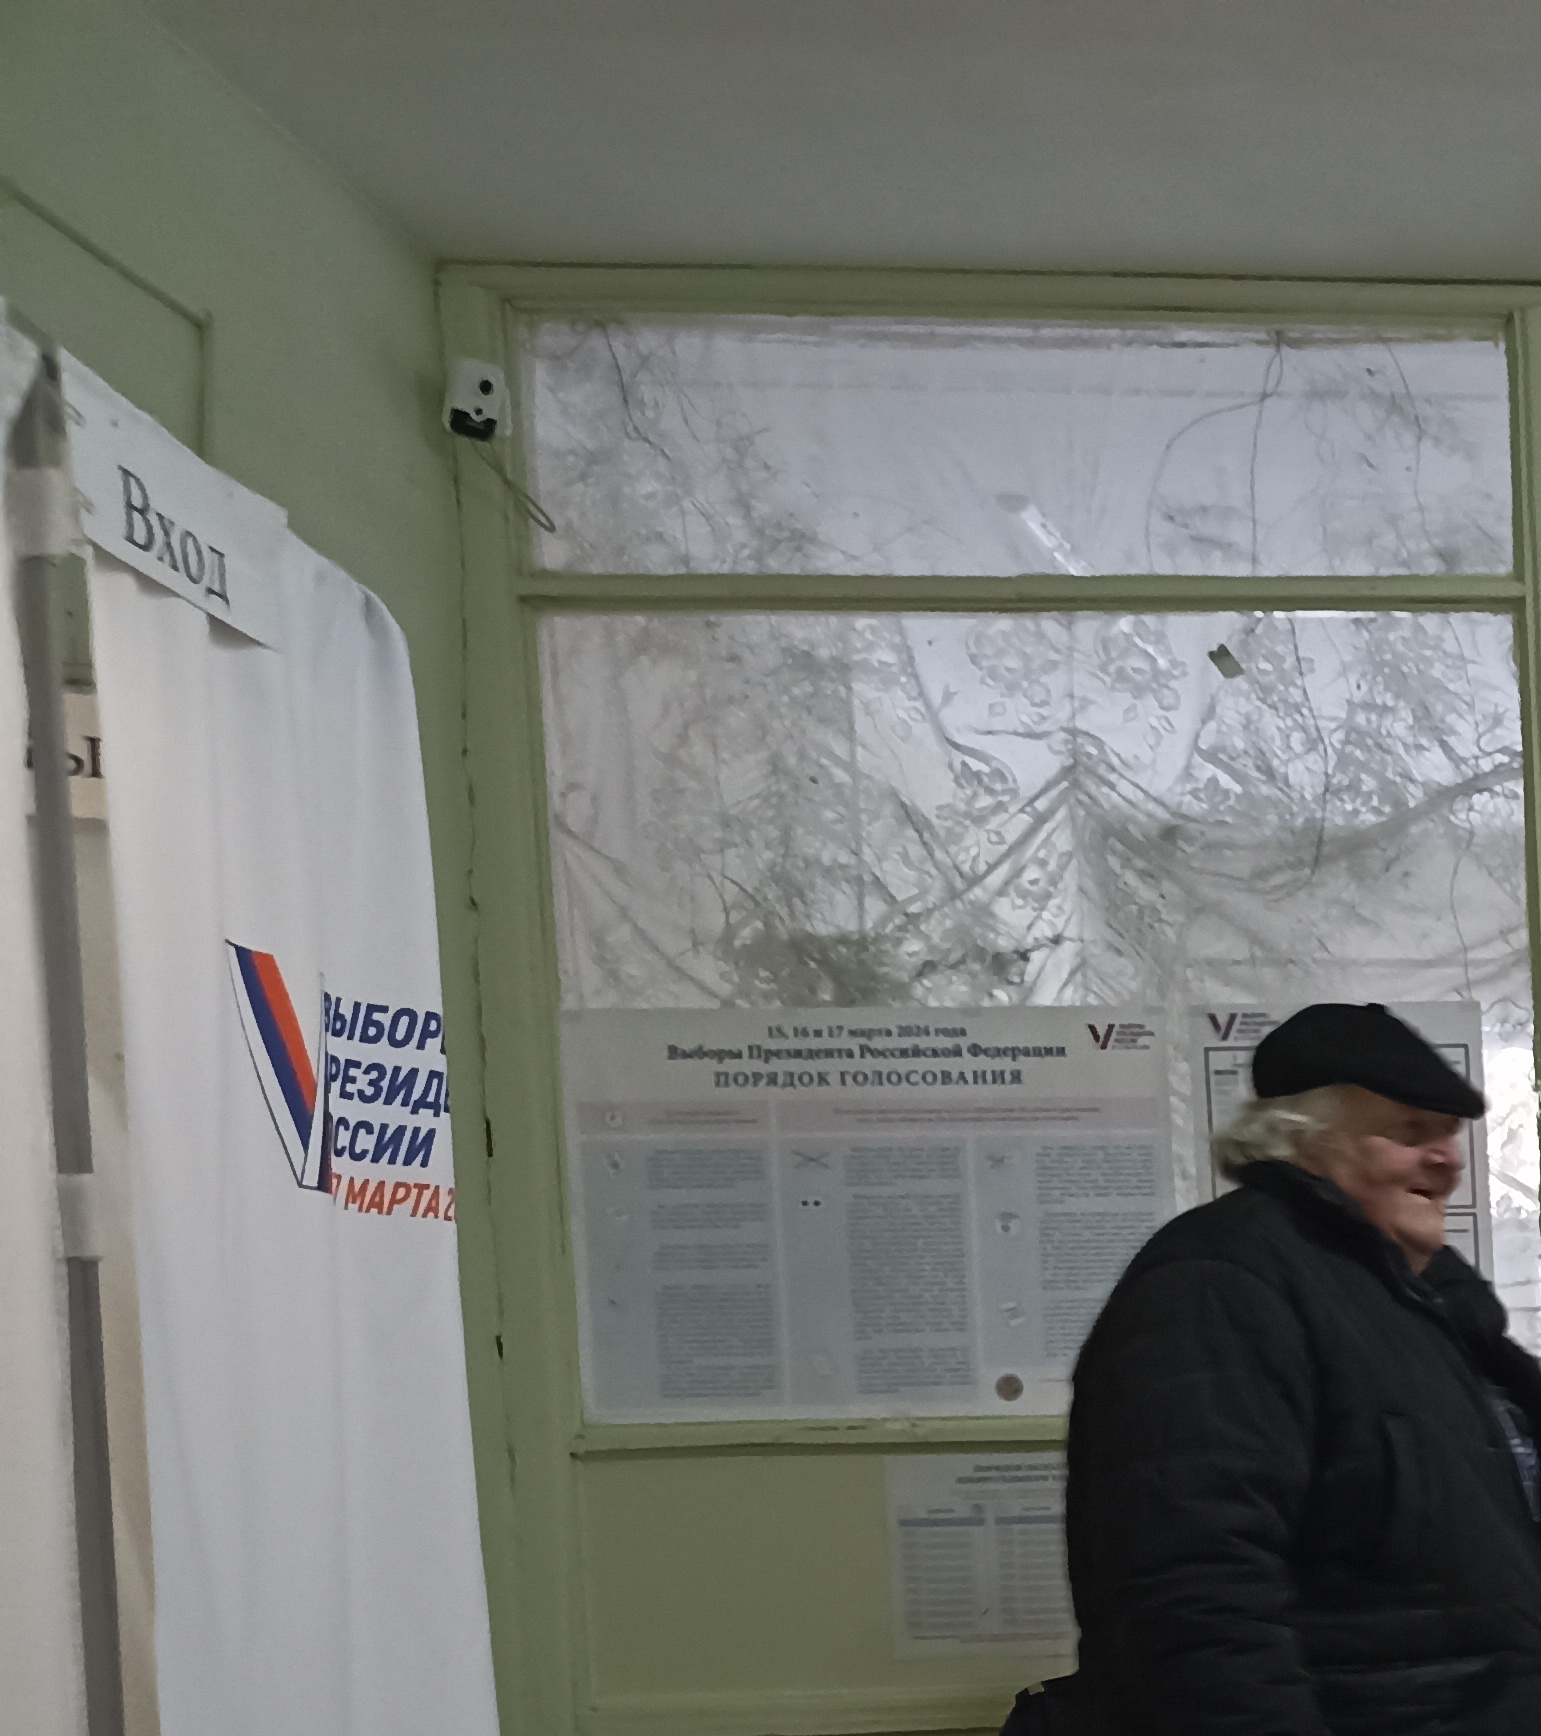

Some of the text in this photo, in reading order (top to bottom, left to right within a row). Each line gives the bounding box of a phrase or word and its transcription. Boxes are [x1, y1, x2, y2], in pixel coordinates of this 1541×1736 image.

[116, 463, 231, 614] Вход
[323, 991, 446, 1055] ЫБОР
[667, 1042, 1067, 1064] Выборы Президента Российской Федерации
[713, 1068, 1023, 1088] ПОРЯДОК ГОЛОСОВАНИЯ
[325, 1052, 450, 1118] РЕЗИД
[343, 1176, 440, 1217] МАРТА
